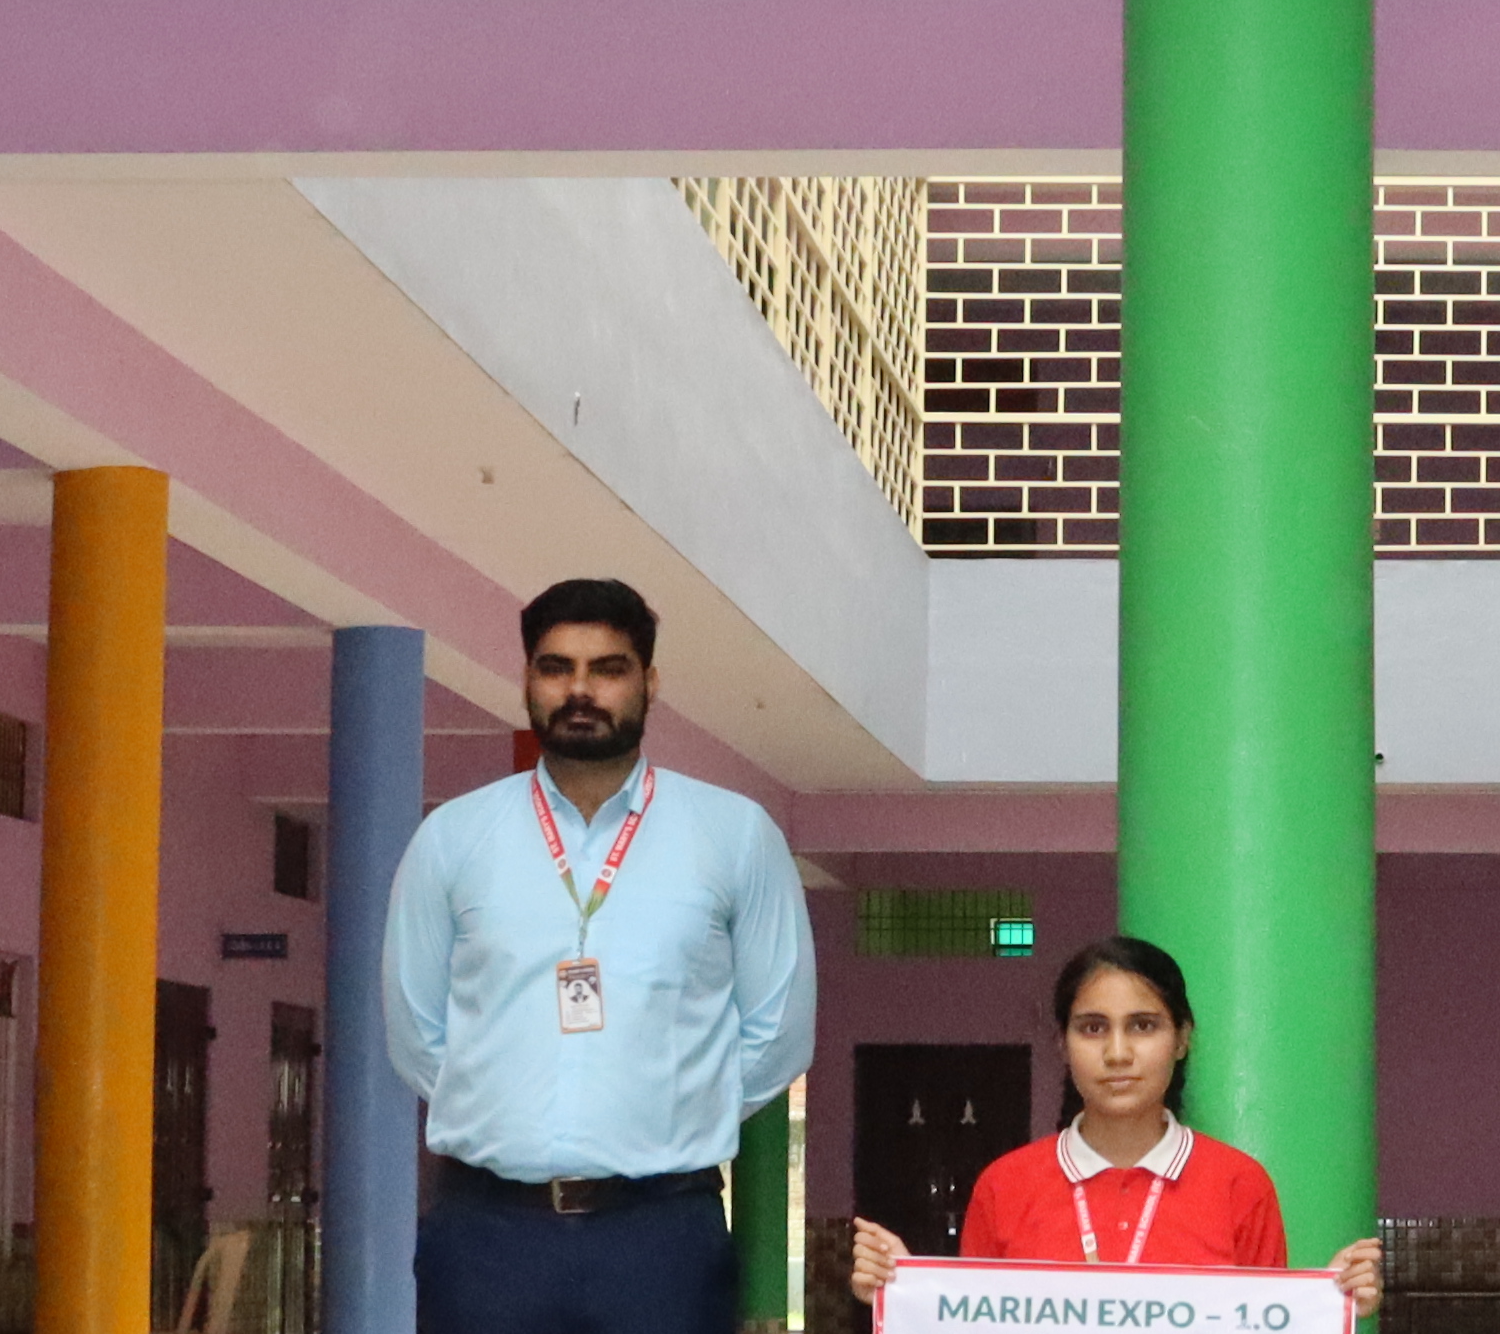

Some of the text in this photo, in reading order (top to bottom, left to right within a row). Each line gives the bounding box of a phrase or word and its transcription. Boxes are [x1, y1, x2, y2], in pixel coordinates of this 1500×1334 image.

[1137, 1192, 1158, 1230] SCHOOL
[937, 1294, 1088, 1326] MARIAN
[1097, 1298, 1195, 1329] EXPO
